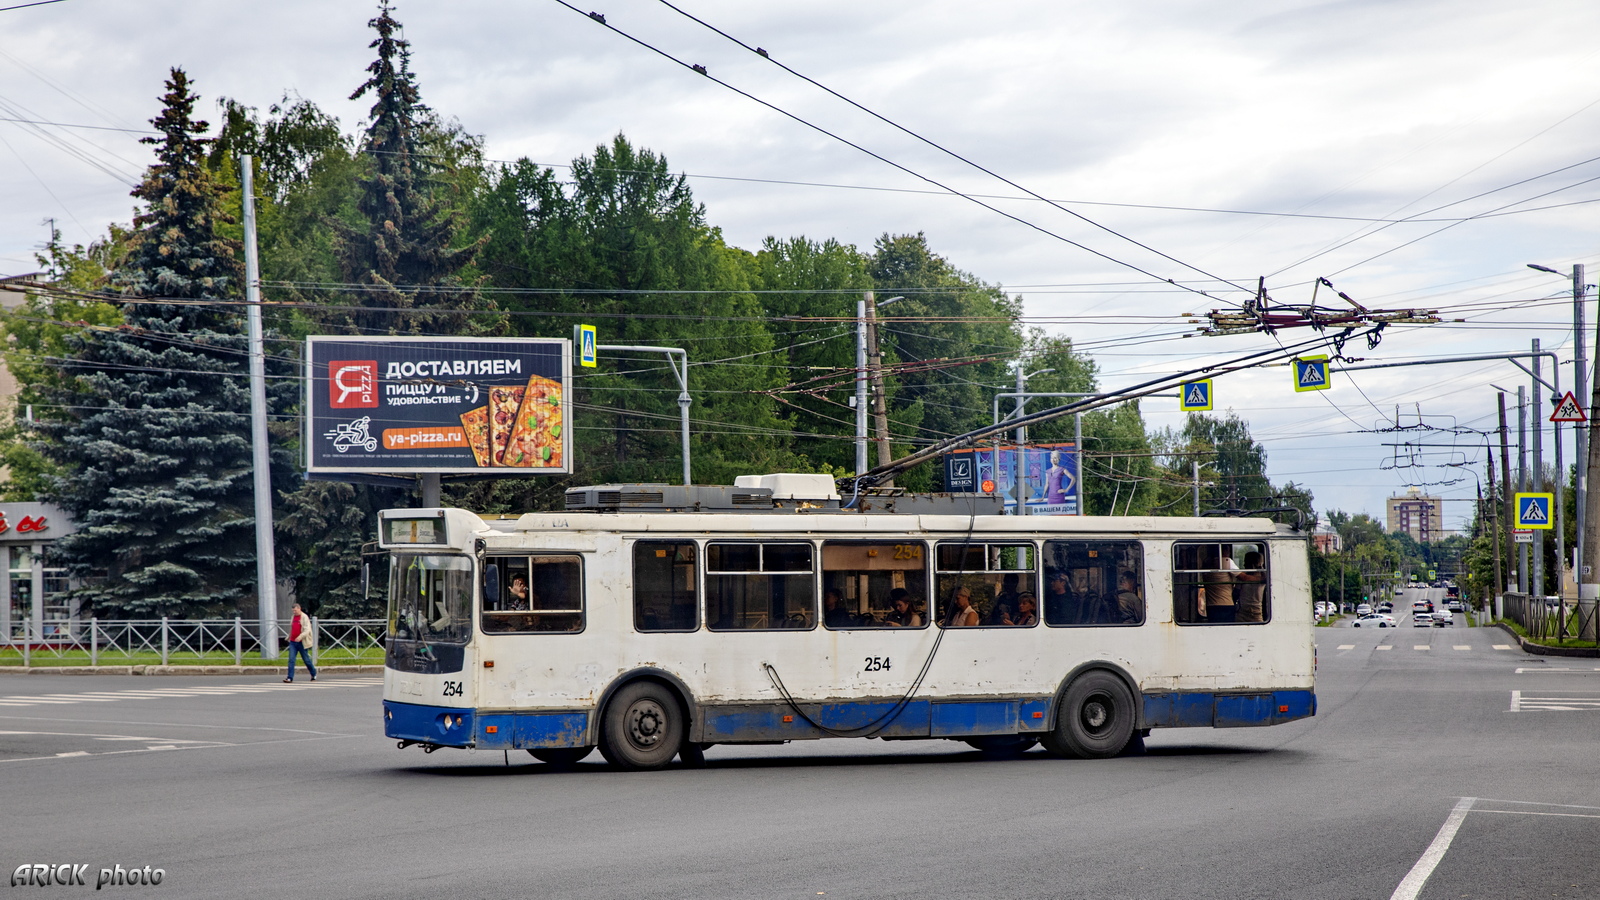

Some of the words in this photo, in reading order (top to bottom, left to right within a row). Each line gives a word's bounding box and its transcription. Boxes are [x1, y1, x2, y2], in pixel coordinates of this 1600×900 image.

[386, 359, 521, 379] ДОСТАВЛЯЕМ
[361, 365, 372, 403] PIZZA
[386, 383, 433, 396] ПИЦЦУ
[387, 396, 462, 406] УДОВОЛЬСТВИЕ
[388, 431, 462, 447] ya-pizza.ru
[894, 544, 922, 559] 254
[864, 656, 891, 671] 254
[443, 681, 463, 697] 254
